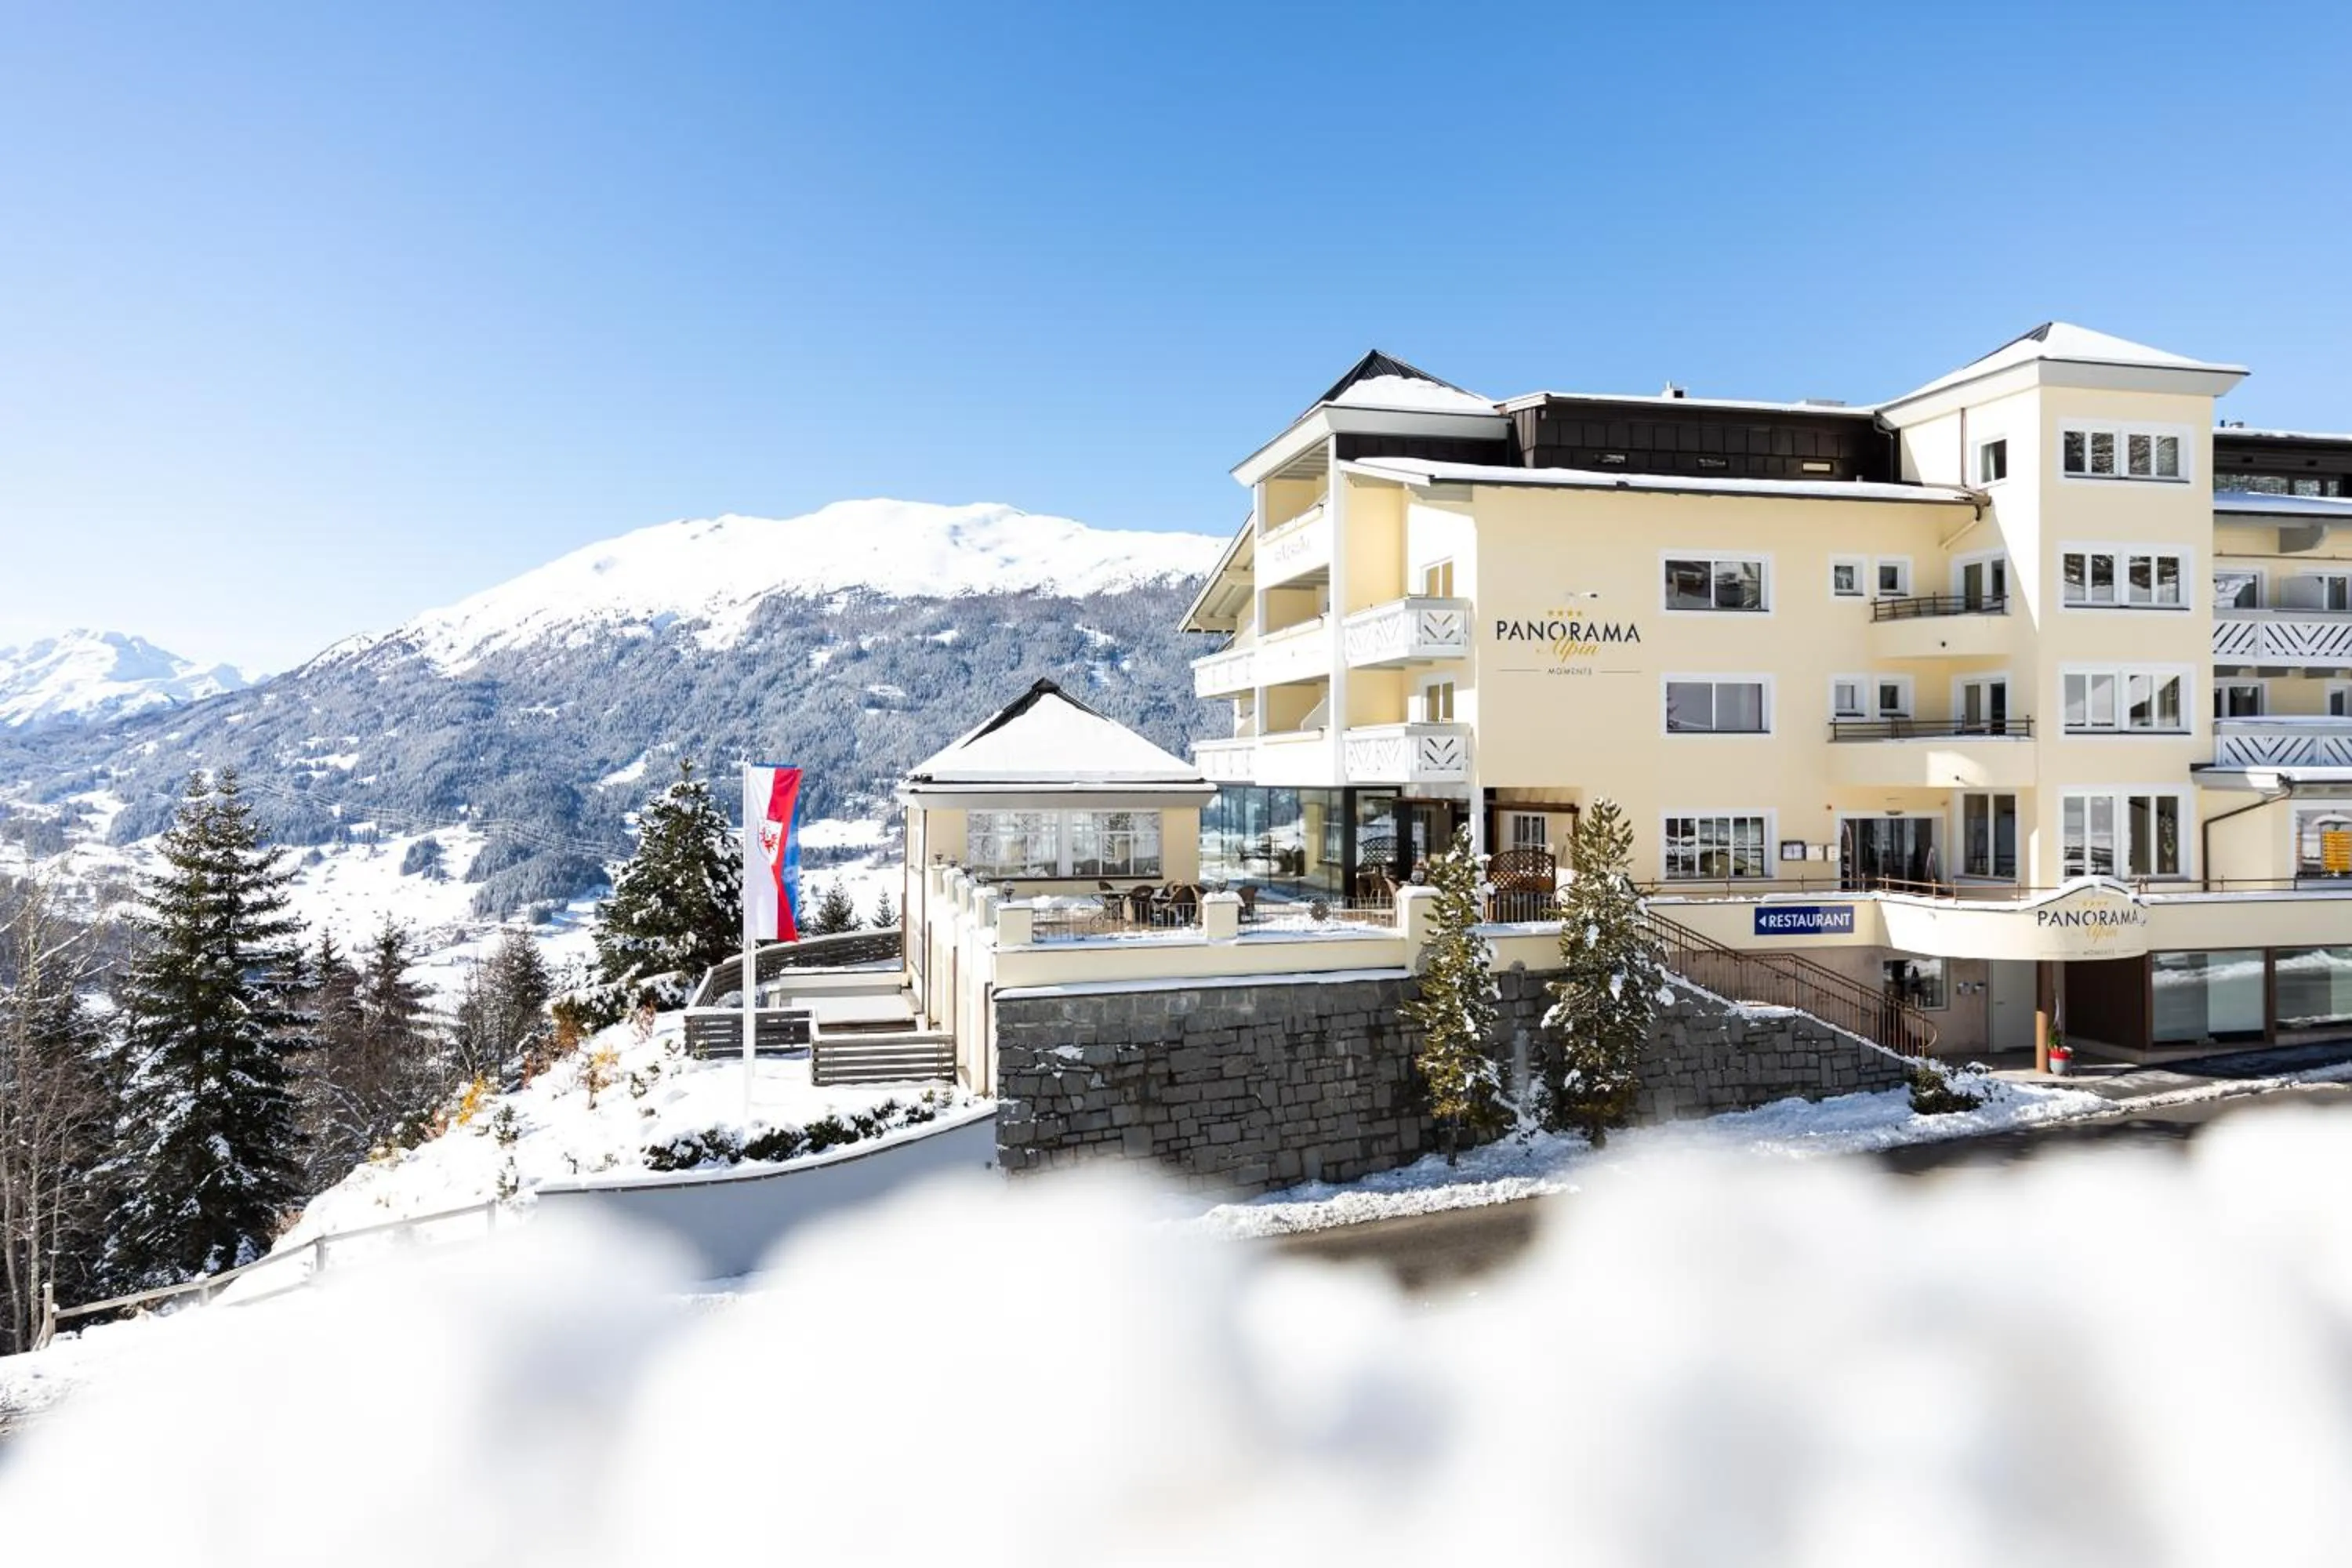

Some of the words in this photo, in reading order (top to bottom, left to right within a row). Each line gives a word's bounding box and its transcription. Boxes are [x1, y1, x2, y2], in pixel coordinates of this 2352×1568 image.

[1496, 620, 1641, 643] PANORAMA
[1768, 913, 1851, 927] RESTAURANT
[2038, 909, 2140, 927] PANORAMA
